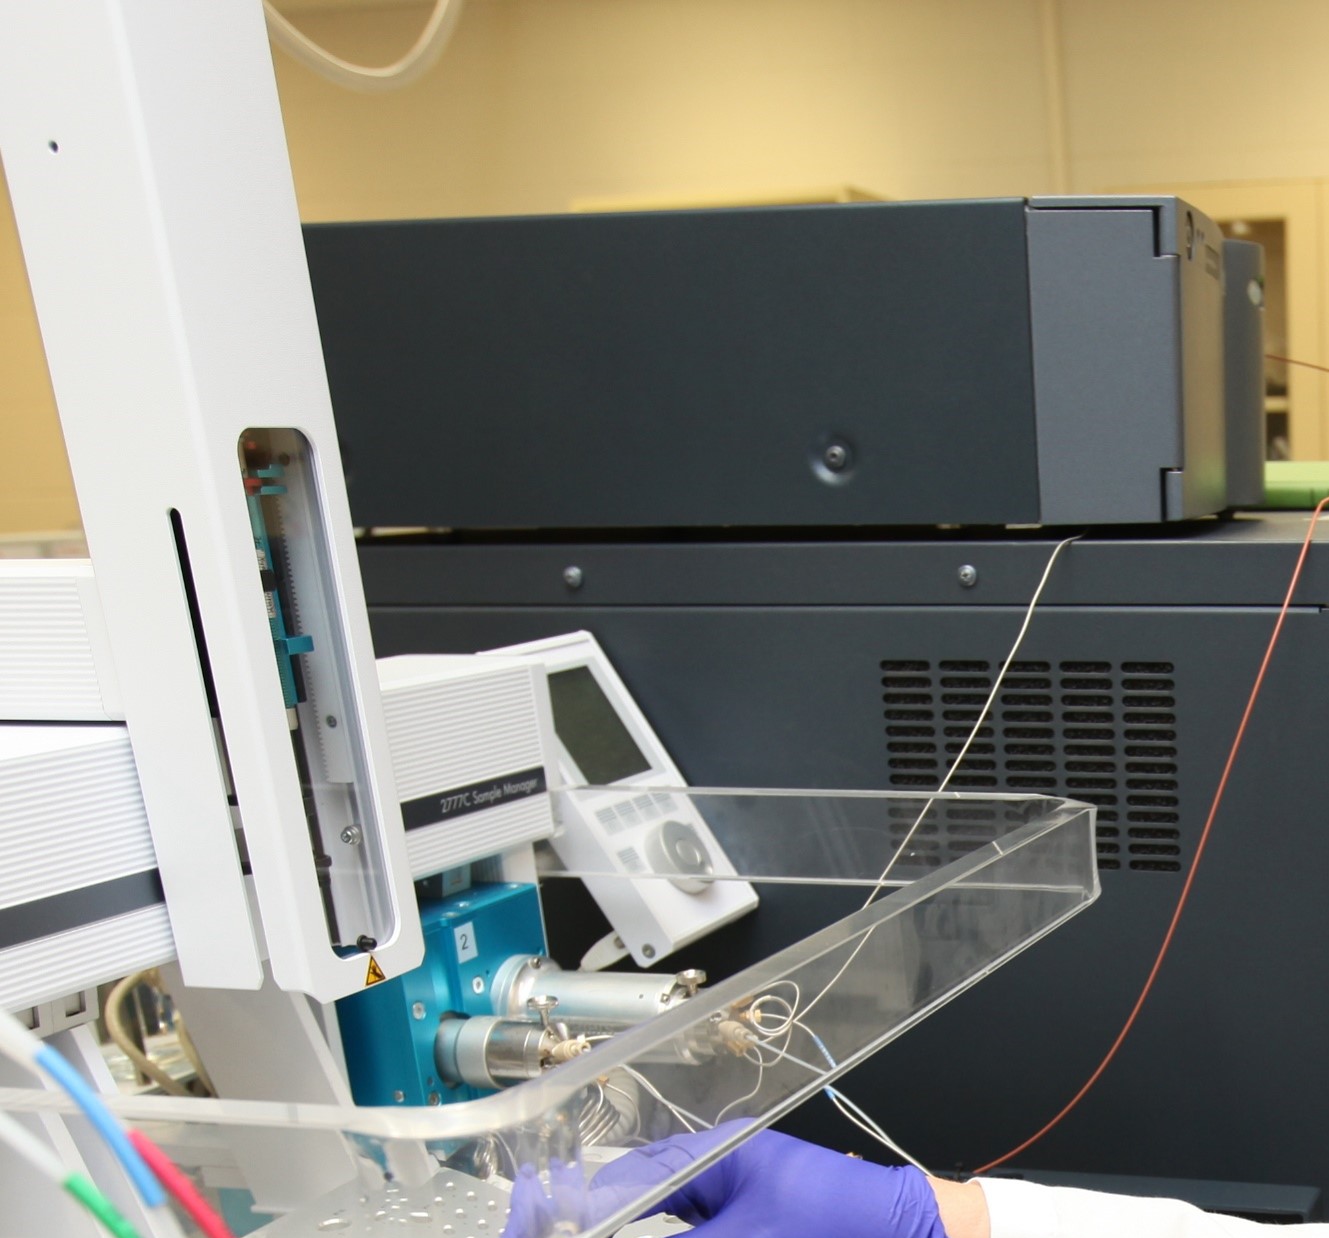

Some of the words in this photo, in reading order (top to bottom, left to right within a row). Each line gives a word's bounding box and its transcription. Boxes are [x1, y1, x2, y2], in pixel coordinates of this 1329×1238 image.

[440, 792, 471, 813] 2777C
[472, 785, 502, 804] Sample
[504, 778, 539, 795] Manager
[460, 933, 469, 951] 2
